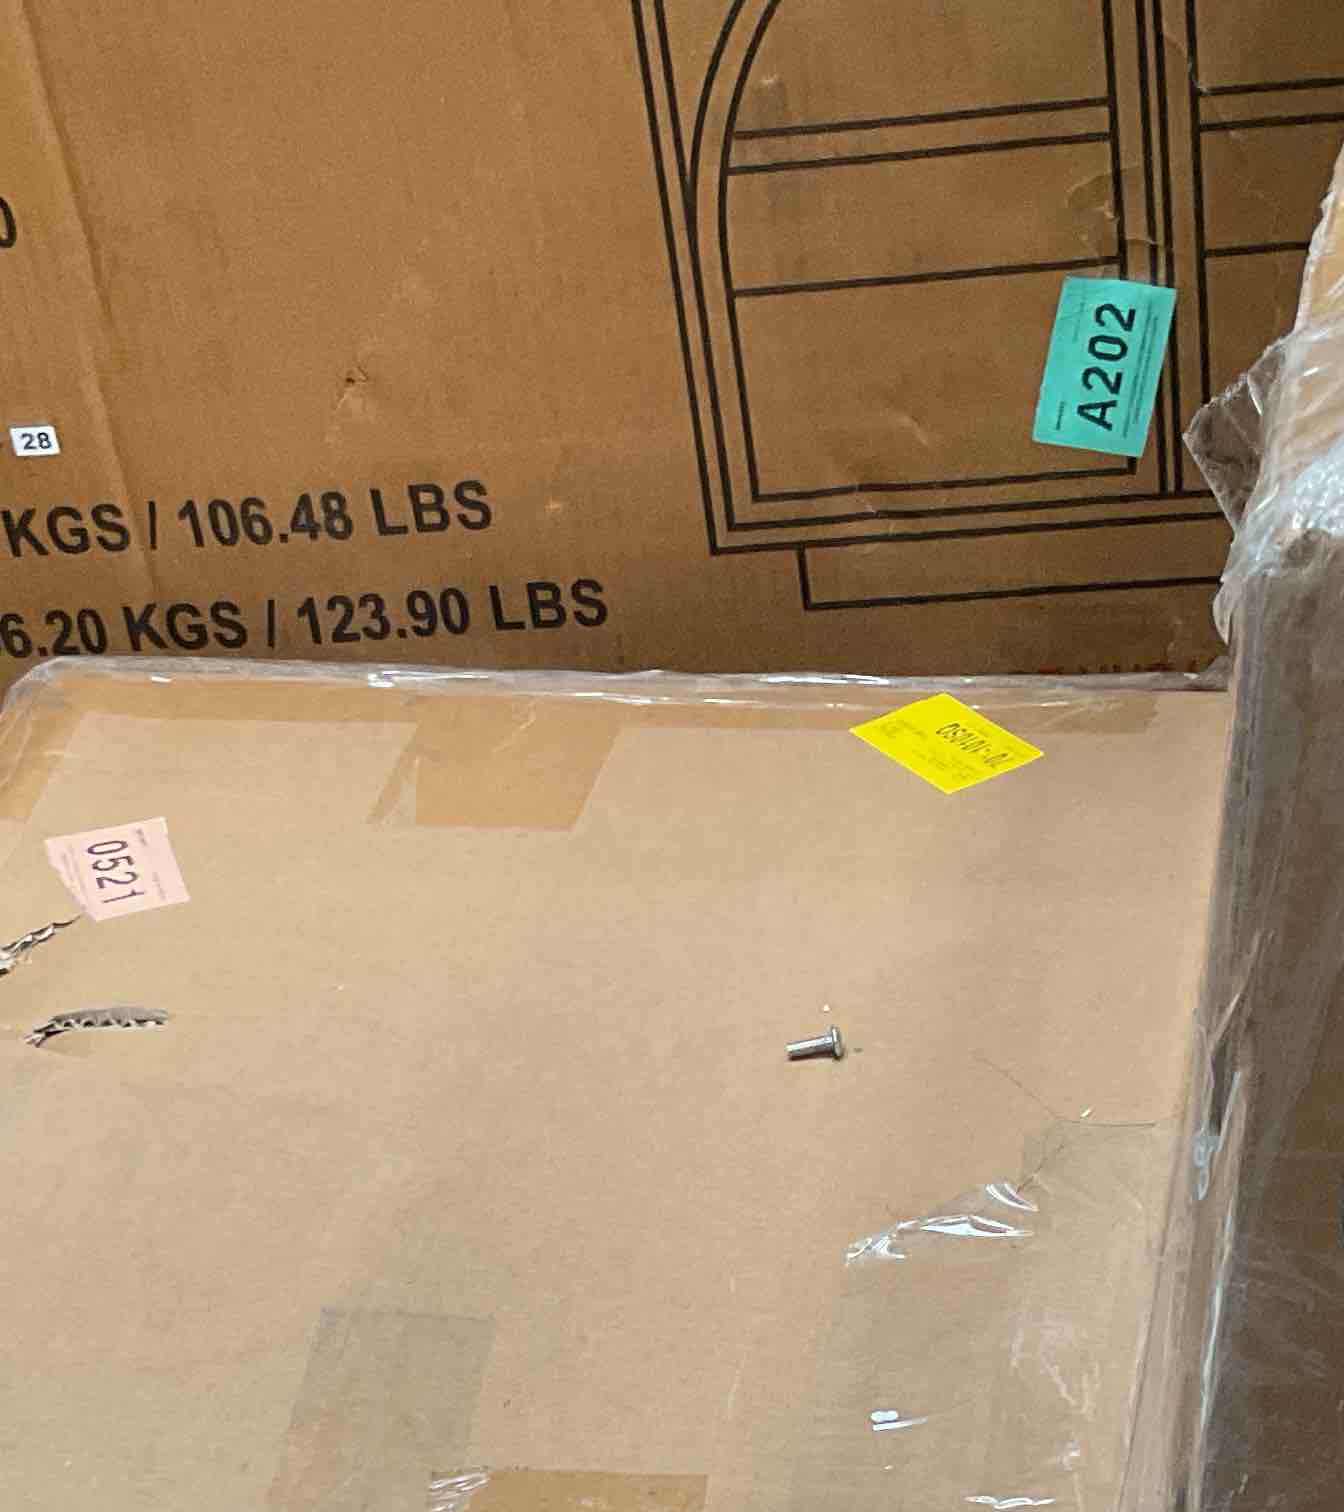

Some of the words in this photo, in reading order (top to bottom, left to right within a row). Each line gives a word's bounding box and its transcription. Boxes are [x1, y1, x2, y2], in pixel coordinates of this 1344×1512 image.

[1076, 303, 1136, 432] A202
[22, 431, 52, 451] 28
[0, 502, 132, 558] KGS
[177, 491, 354, 548] 106.48
[368, 479, 493, 537] LBS
[122, 600, 248, 652] KGS
[296, 586, 471, 645] 123.90
[488, 577, 610, 633] LBS
[87, 840, 145, 904] 0521
